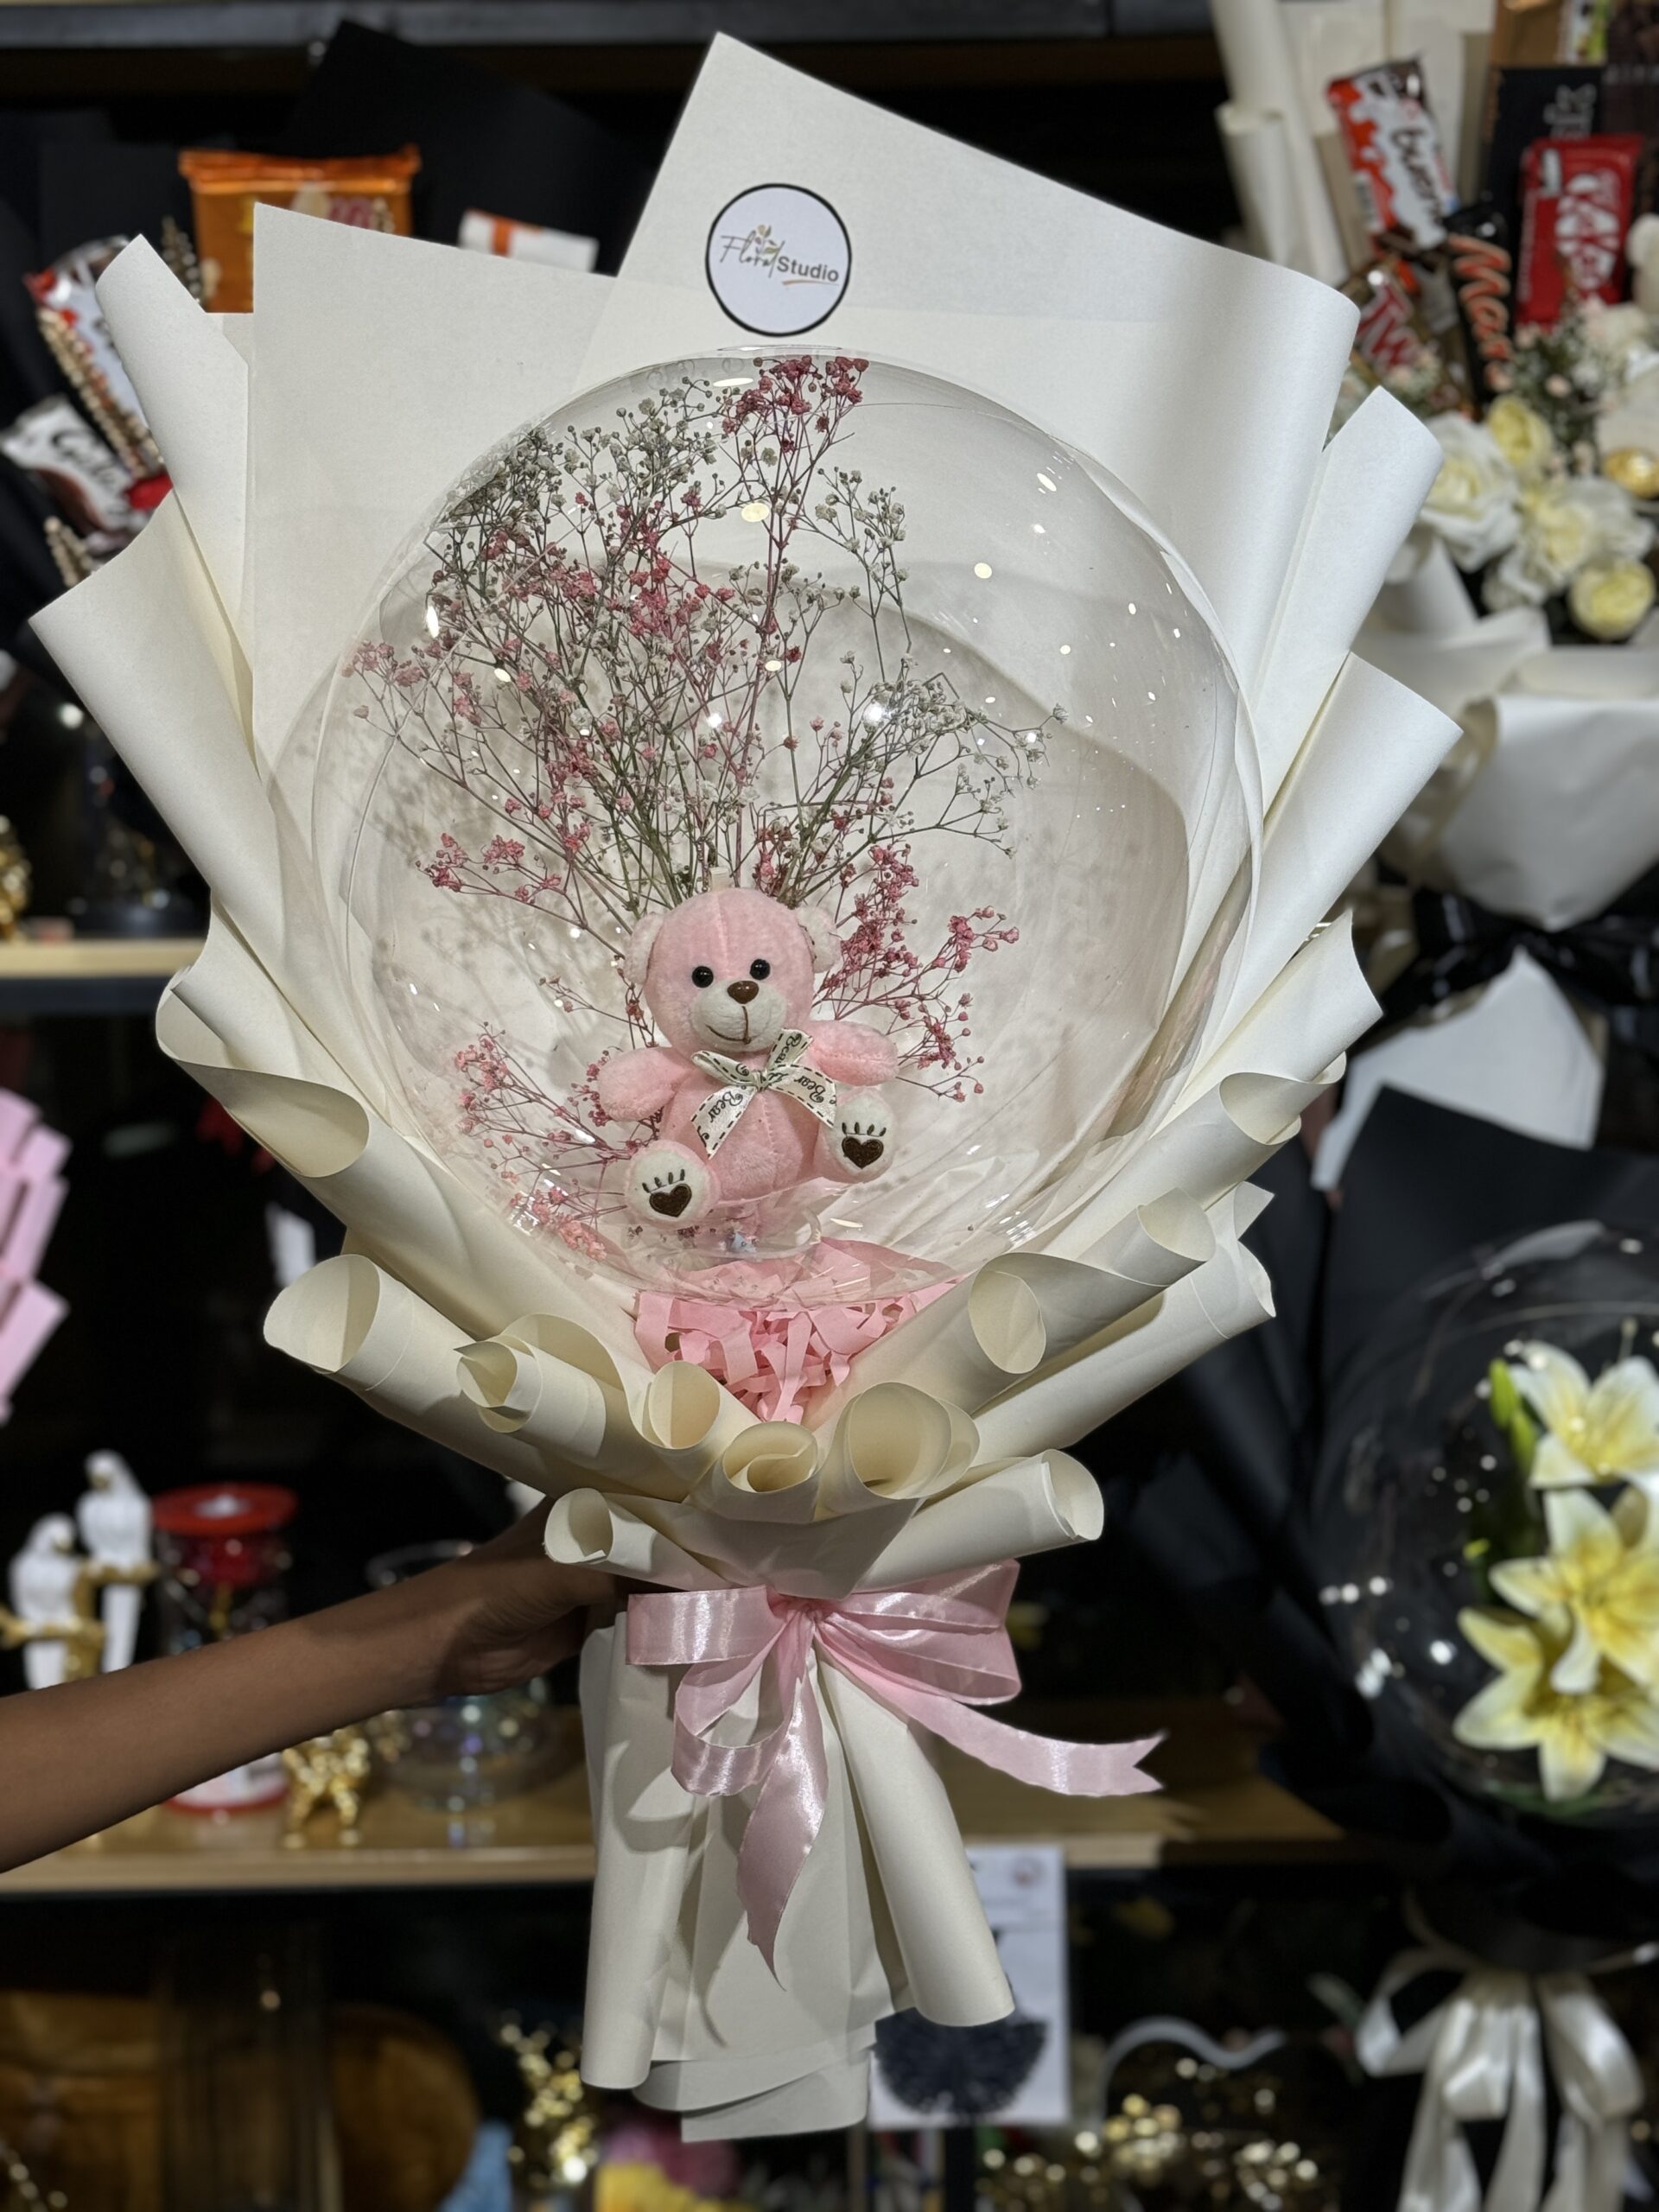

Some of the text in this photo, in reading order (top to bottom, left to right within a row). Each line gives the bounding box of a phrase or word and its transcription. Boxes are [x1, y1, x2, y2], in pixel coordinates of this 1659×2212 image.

[719, 230, 839, 282] Floral Studio
[794, 1075, 825, 1103] Bear
[708, 1090, 743, 1123] Bear
